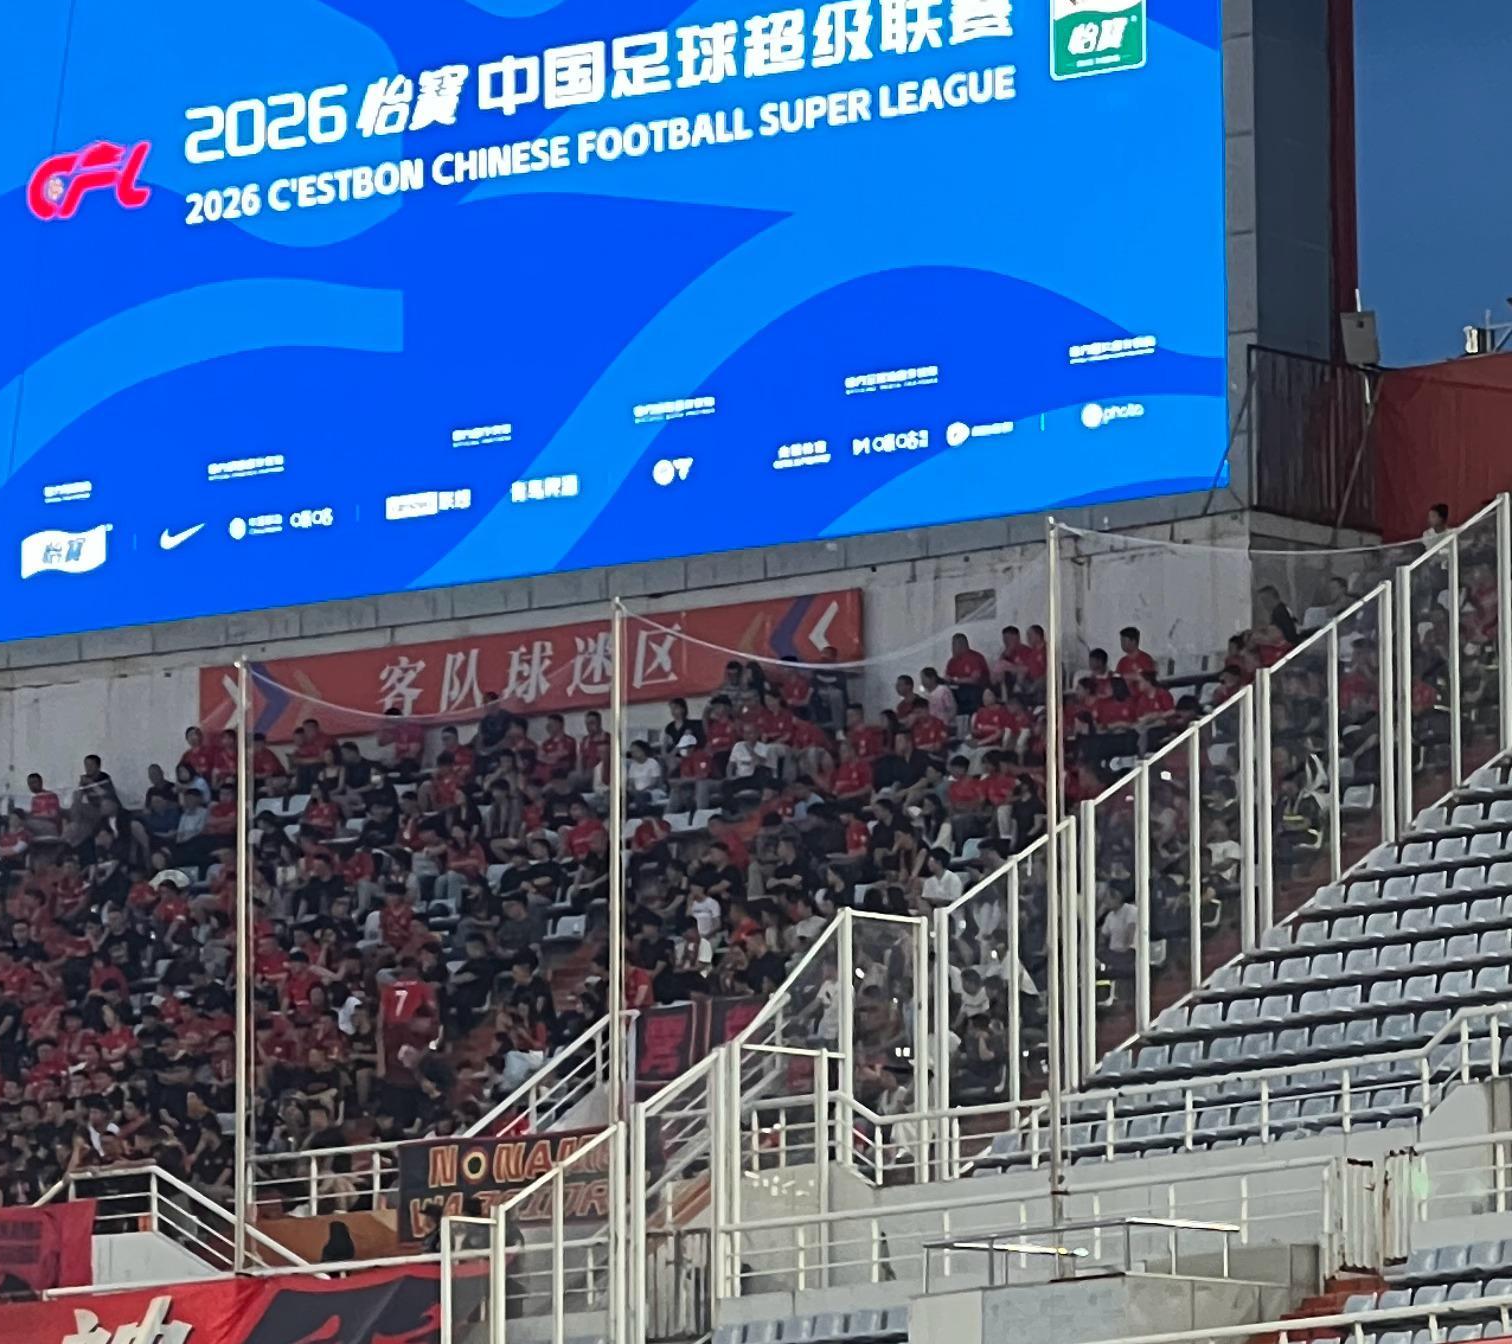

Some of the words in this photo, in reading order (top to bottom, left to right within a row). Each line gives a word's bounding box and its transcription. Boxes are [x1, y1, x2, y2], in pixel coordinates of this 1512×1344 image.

[185, 83, 348, 165] 2026
[185, 184, 261, 225] 2026
[268, 158, 425, 212] C'ESTBON
[432, 134, 571, 186] CHINESE
[578, 107, 754, 166] FOOTBALL
[760, 89, 872, 138] SUPER
[879, 65, 1017, 120] LEAGUE
[377, 624, 684, 716] 客队球迷区
[395, 990, 409, 1017] 7
